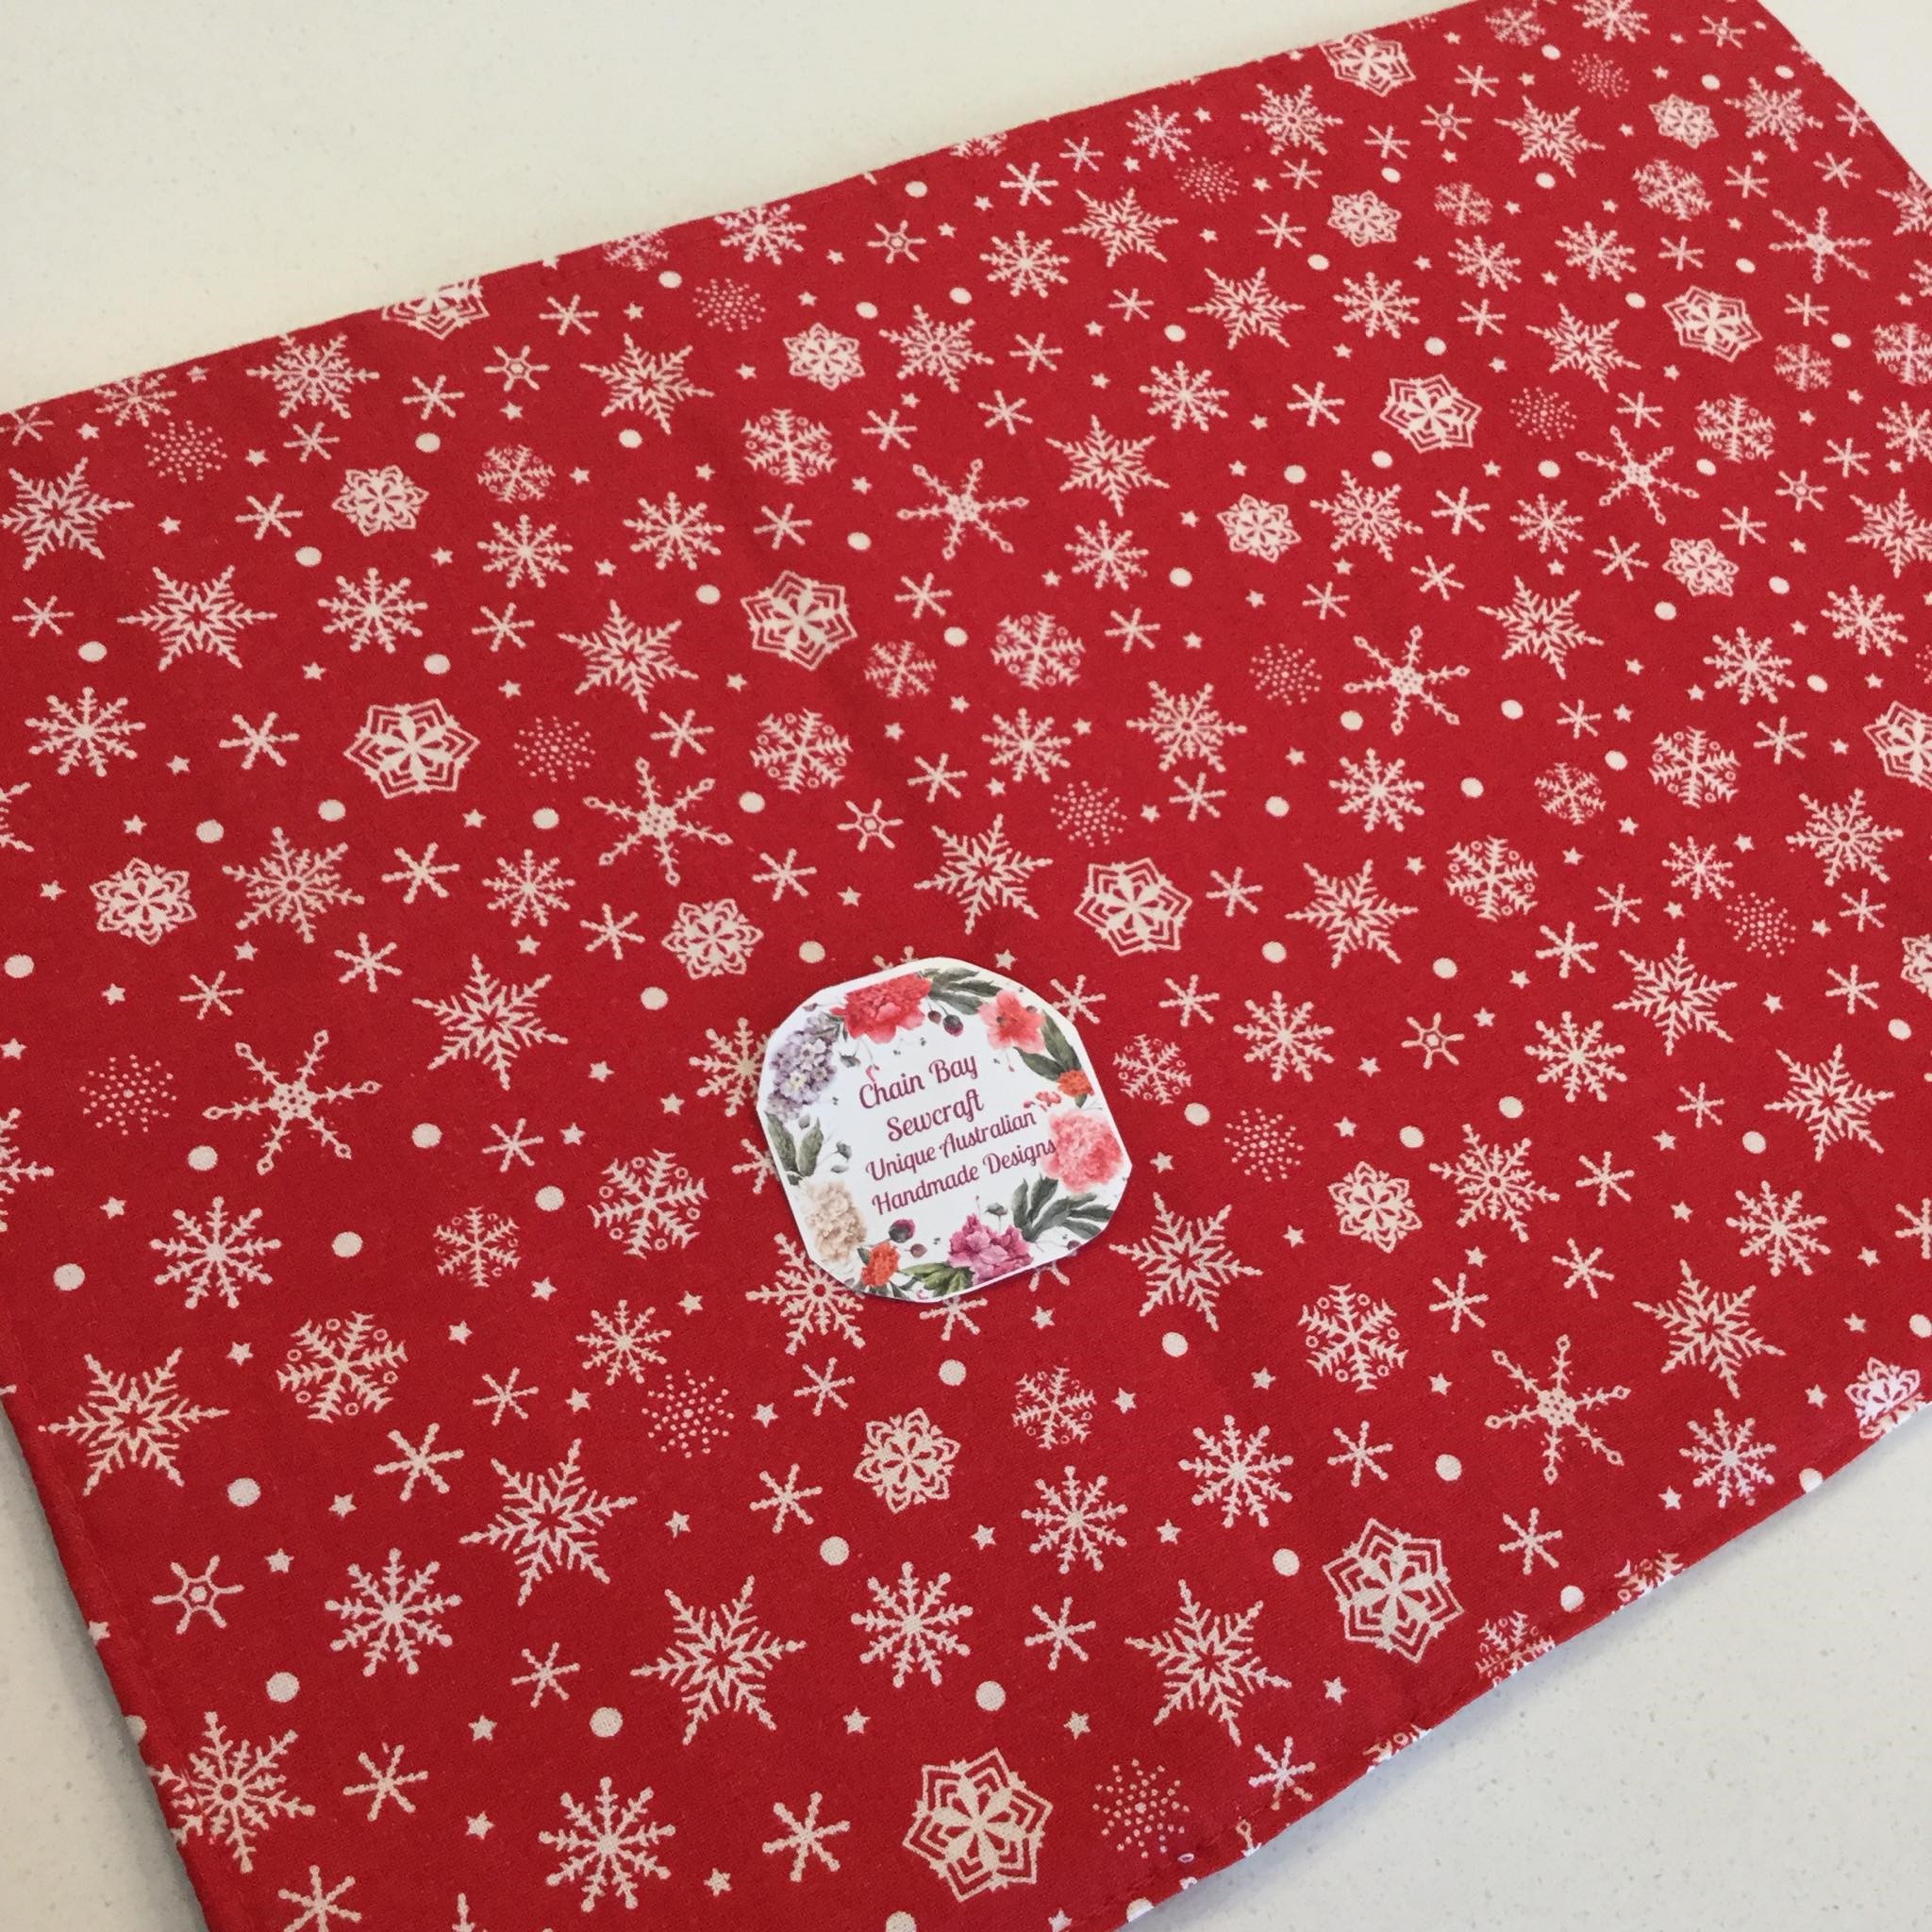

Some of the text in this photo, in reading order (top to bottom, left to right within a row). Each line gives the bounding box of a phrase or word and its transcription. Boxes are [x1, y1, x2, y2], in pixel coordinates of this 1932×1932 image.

[859, 1056, 978, 1108] Chain Bay
[887, 1089, 984, 1141] Sewcraft
[865, 1111, 1037, 1181] Unique Australian
[872, 1139, 1057, 1215] Handmade Designs
